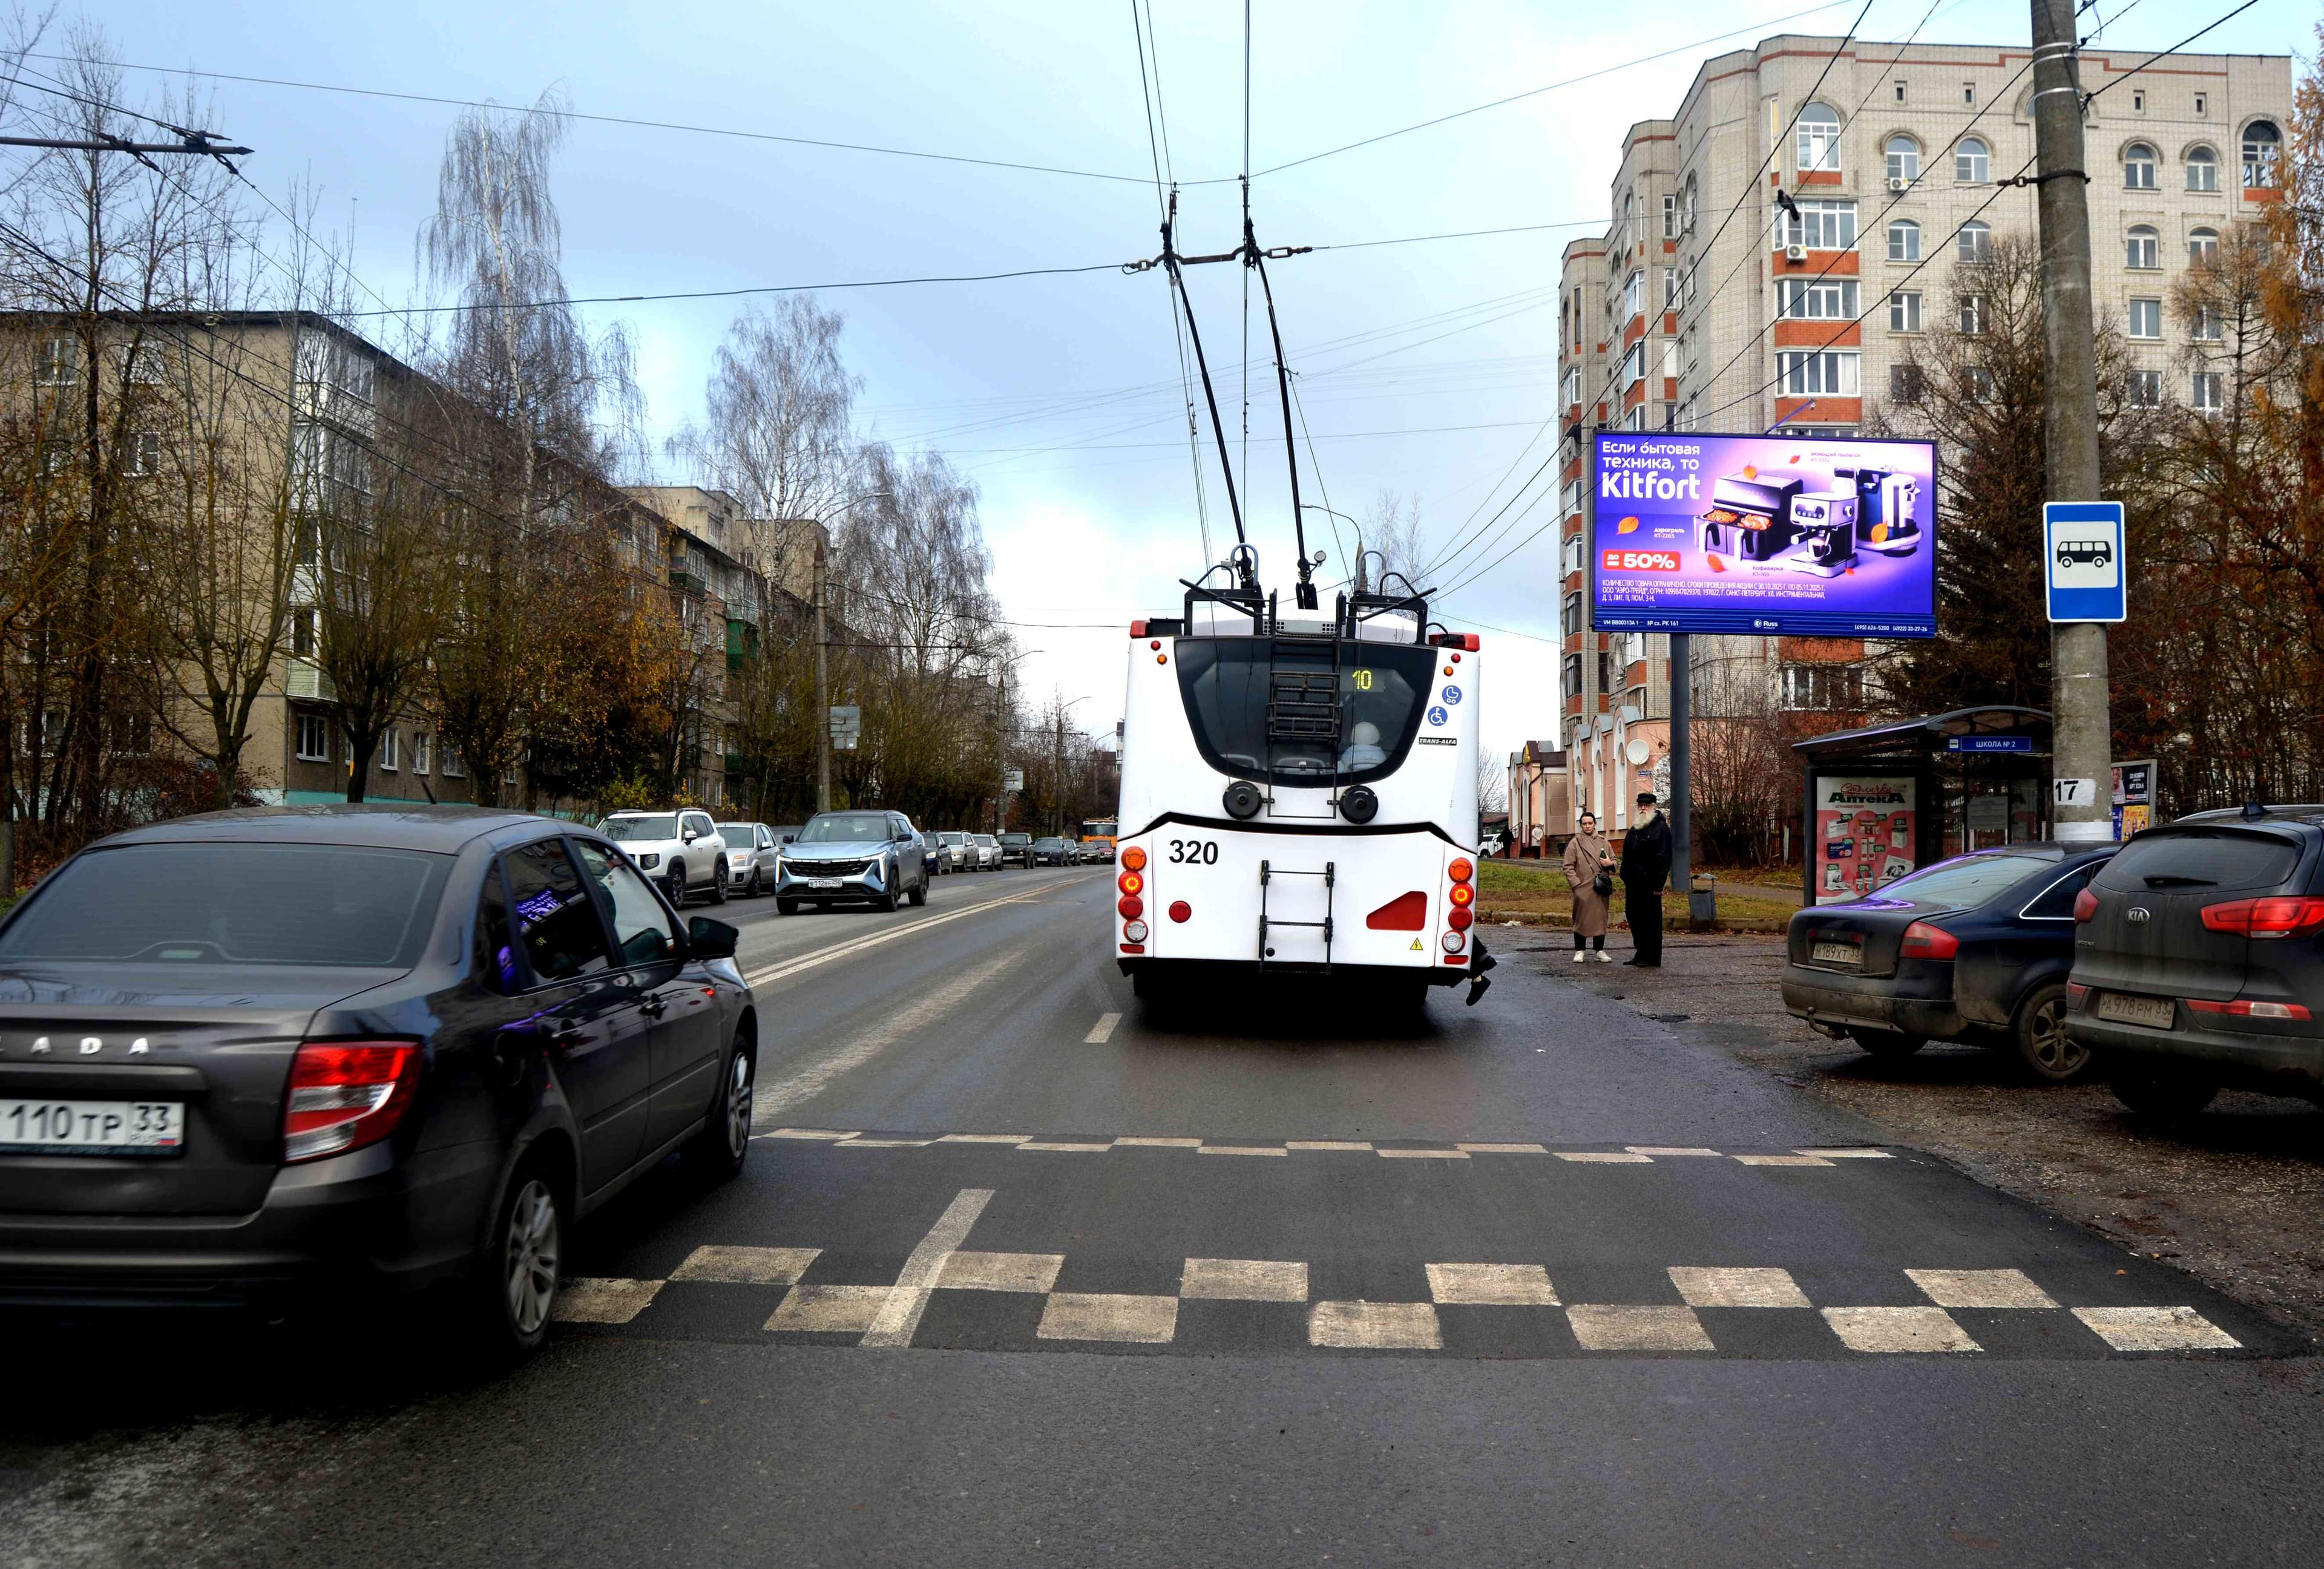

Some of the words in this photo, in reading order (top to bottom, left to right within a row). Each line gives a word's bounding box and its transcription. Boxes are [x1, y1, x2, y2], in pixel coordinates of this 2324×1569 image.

[1603, 441, 1635, 453] Если
[1640, 442, 1700, 454] бытовая
[1603, 456, 1675, 471] техника,
[1680, 459, 1699, 470] то
[1602, 470, 1700, 499] Kitfort
[1352, 670, 1372, 690] 10
[1840, 783, 1894, 794] Столички
[2055, 780, 2079, 802] 17
[1169, 839, 1218, 865] 320
[2128, 911, 2144, 921] KIA
[1816, 945, 1848, 960] М189ХТ
[1850, 947, 1860, 957] 33
[0, 1104, 123, 1141] 110ТР
[133, 1105, 170, 1131] 33
